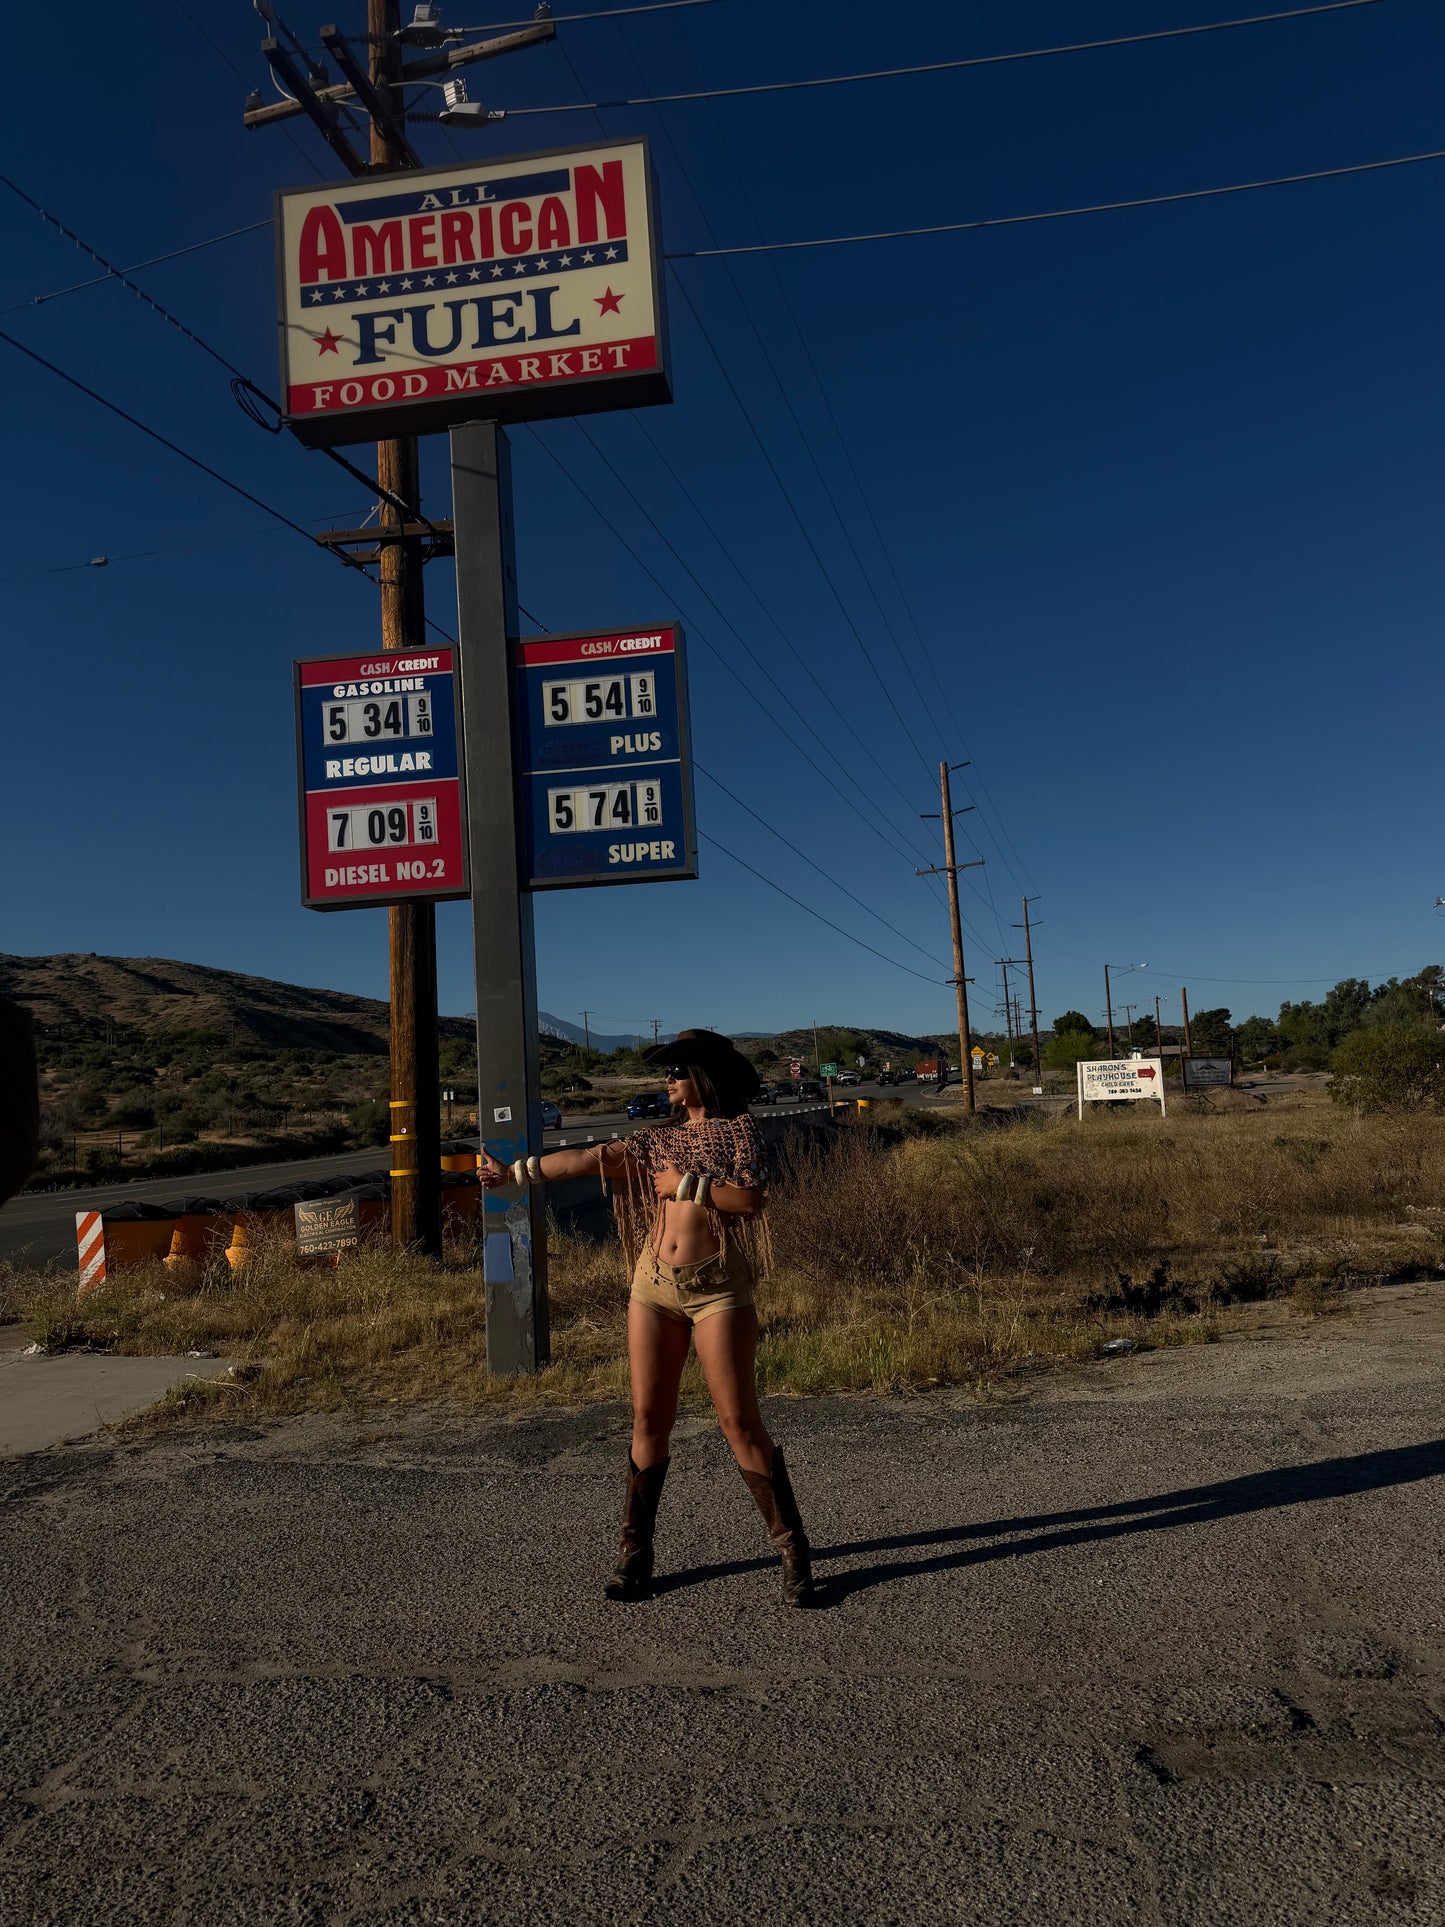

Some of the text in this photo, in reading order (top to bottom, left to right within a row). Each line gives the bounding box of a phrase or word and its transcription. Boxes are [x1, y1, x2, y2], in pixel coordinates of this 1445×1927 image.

[418, 185, 496, 211] ALL
[299, 160, 627, 284] AMERICAN
[352, 286, 580, 366] FUEL
[312, 344, 631, 409] FOOD MARKET
[581, 637, 662, 655] CASH/CREDIT
[360, 657, 439, 675] CASH/CREDIT
[333, 677, 424, 698] GASOLINE
[610, 732, 662, 755] PLUS
[326, 752, 432, 778] REGULAR
[608, 841, 675, 864] SUPER
[325, 859, 445, 887] DIESEL NO.2
[1087, 1072, 1137, 1080] PLAYHOUSE
[300, 1218, 354, 1232] GOLDEN EAGLE
[300, 1237, 358, 1254] 760-422-7890
